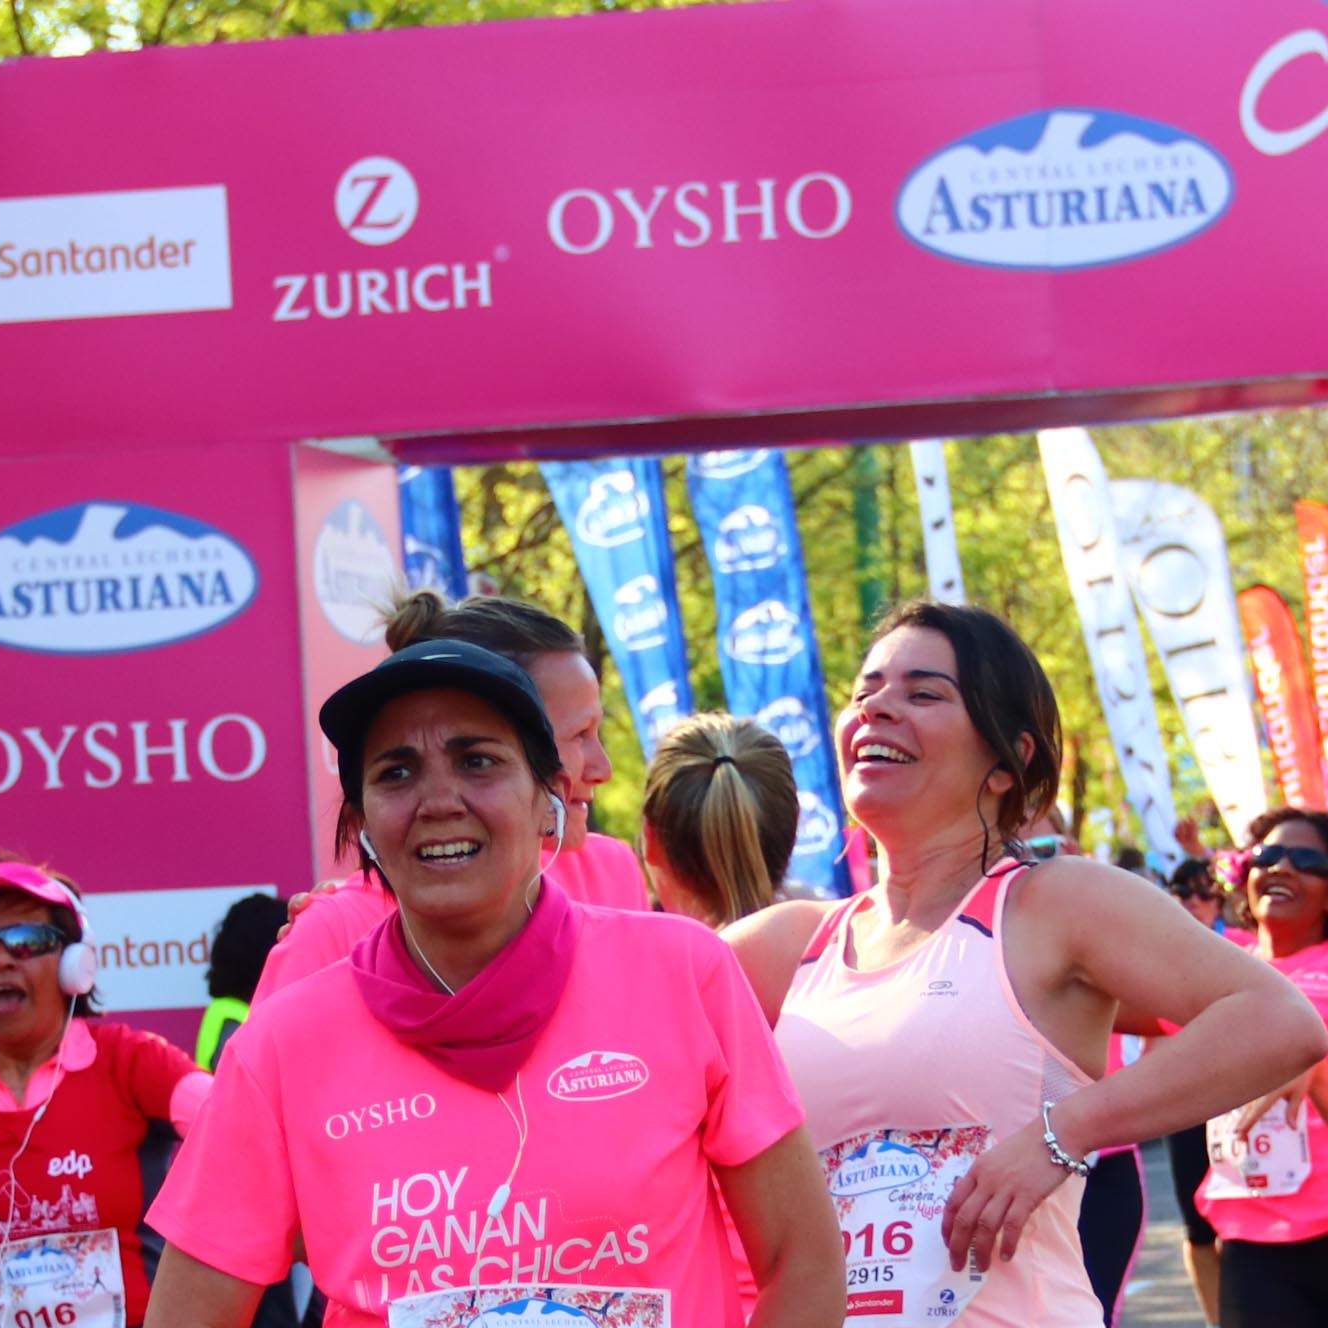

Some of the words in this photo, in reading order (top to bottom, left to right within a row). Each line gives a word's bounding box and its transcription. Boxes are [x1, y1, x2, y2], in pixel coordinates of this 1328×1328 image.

[547, 172, 853, 255] OYSHO
[922, 175, 1208, 236] ASTURIANA
[272, 262, 493, 322] ZURICH
[557, 1069, 644, 1094] ASTURIANA
[325, 1092, 437, 1141] OYSHO
[47, 1149, 94, 1179] edp
[835, 1163, 922, 1188] ASTURIANA
[372, 1165, 469, 1225] HOY
[888, 1188, 935, 1203] Carrera
[915, 1200, 945, 1221] Muje
[372, 1197, 547, 1268] GANAN
[5, 1262, 72, 1281] ASTURIANA
[470, 1223, 650, 1290] CHICAS
[926, 1306, 959, 1318] ZURIC
